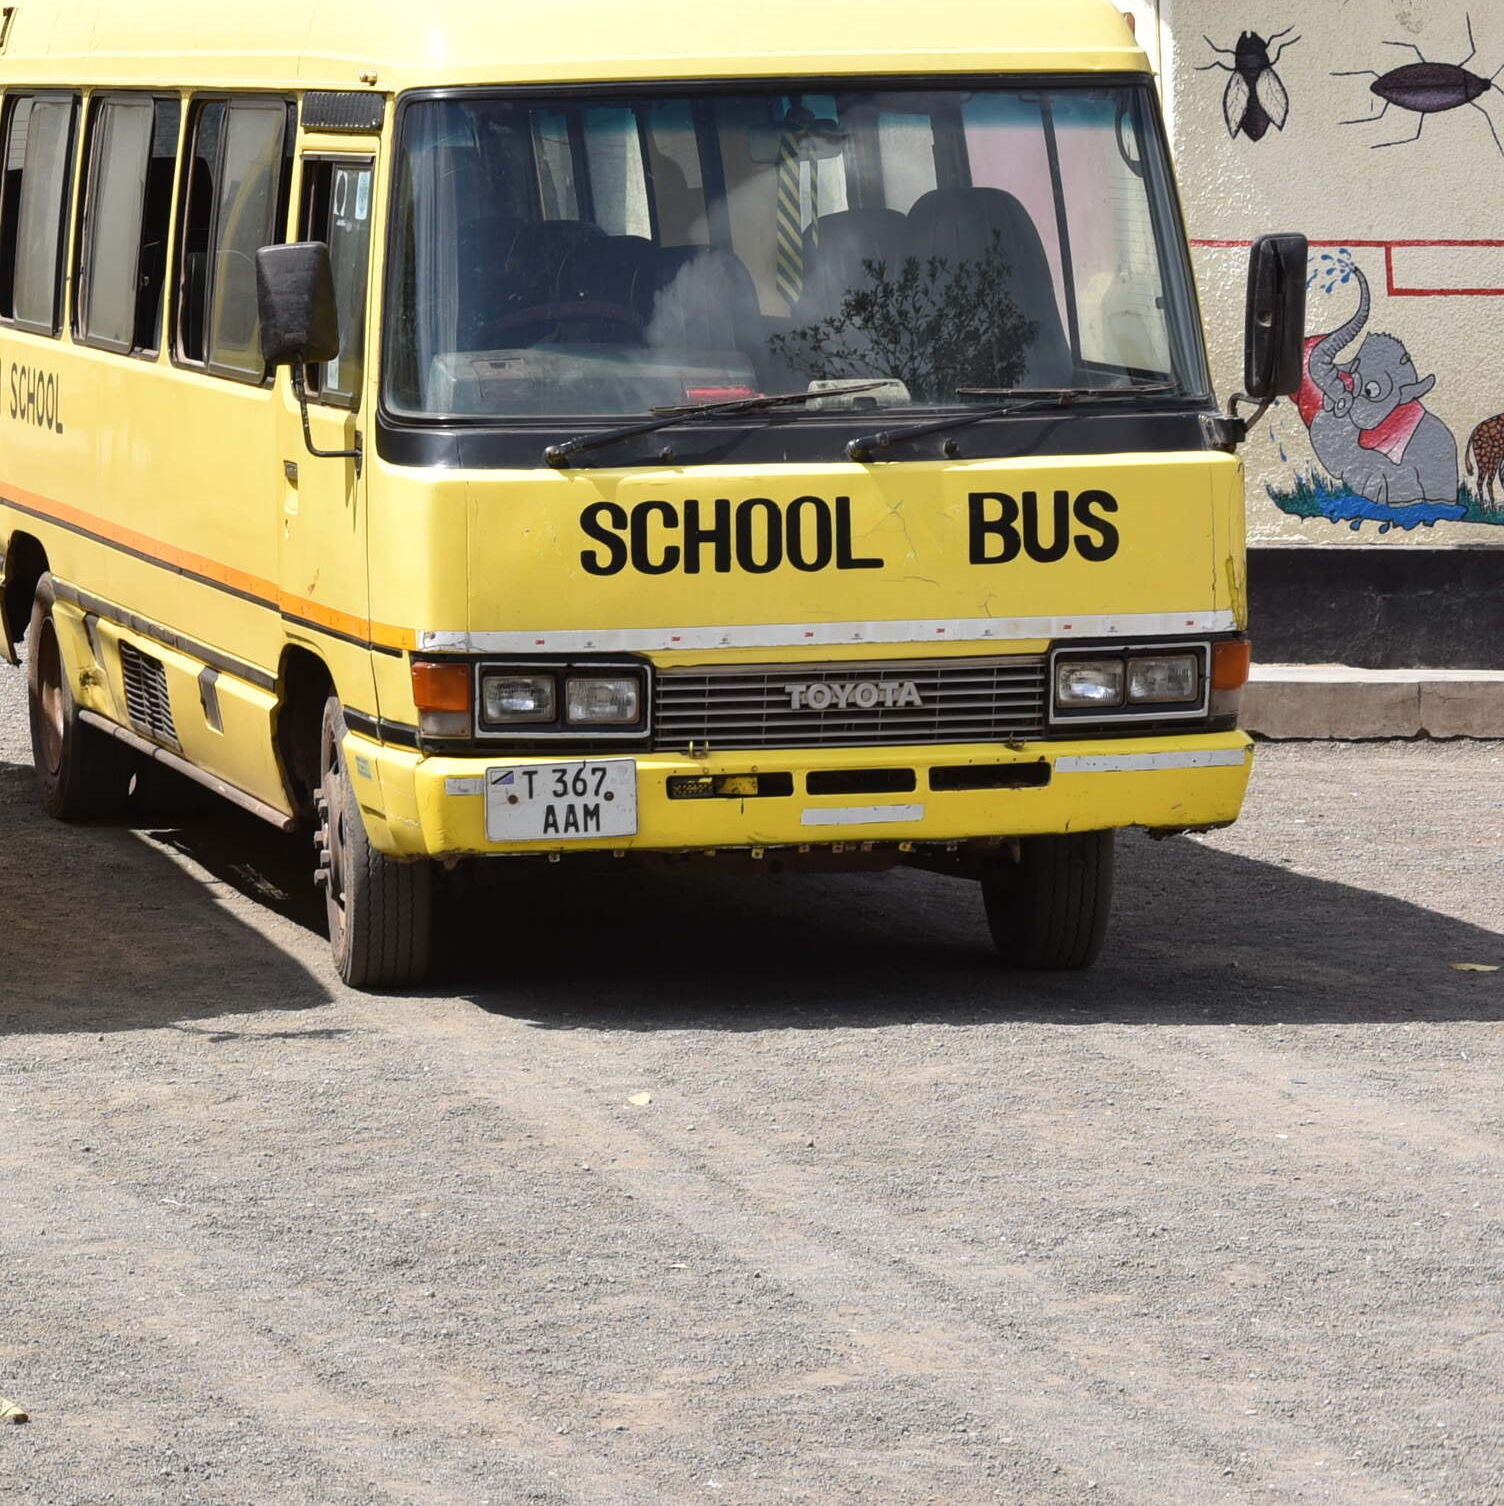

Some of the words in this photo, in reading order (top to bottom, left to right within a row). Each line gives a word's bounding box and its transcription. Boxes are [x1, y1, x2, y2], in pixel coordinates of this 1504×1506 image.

[10, 362, 63, 434] SCHOOL
[580, 495, 884, 576] SCHOOL
[968, 489, 1120, 564] BUS
[784, 681, 923, 710] TOYOTA
[551, 767, 607, 798] 367
[543, 803, 600, 834] AAM
